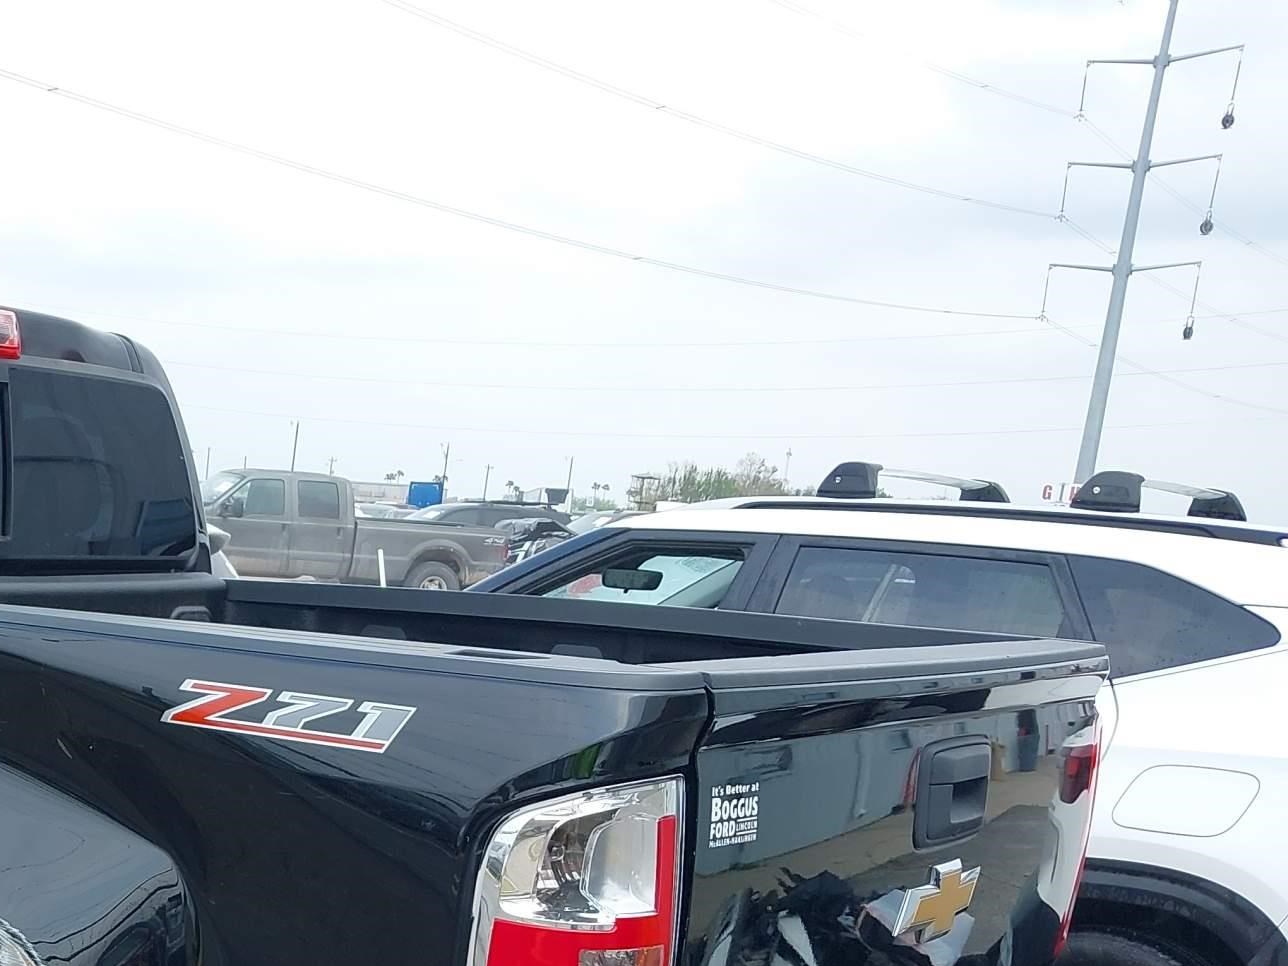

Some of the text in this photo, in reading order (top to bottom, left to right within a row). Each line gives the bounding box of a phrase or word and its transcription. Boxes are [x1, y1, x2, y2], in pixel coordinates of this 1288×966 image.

[160, 678, 417, 754] Z71
[711, 781, 760, 797] It's Better at
[711, 796, 758, 822] BOGGUS
[710, 820, 736, 840] FORD
